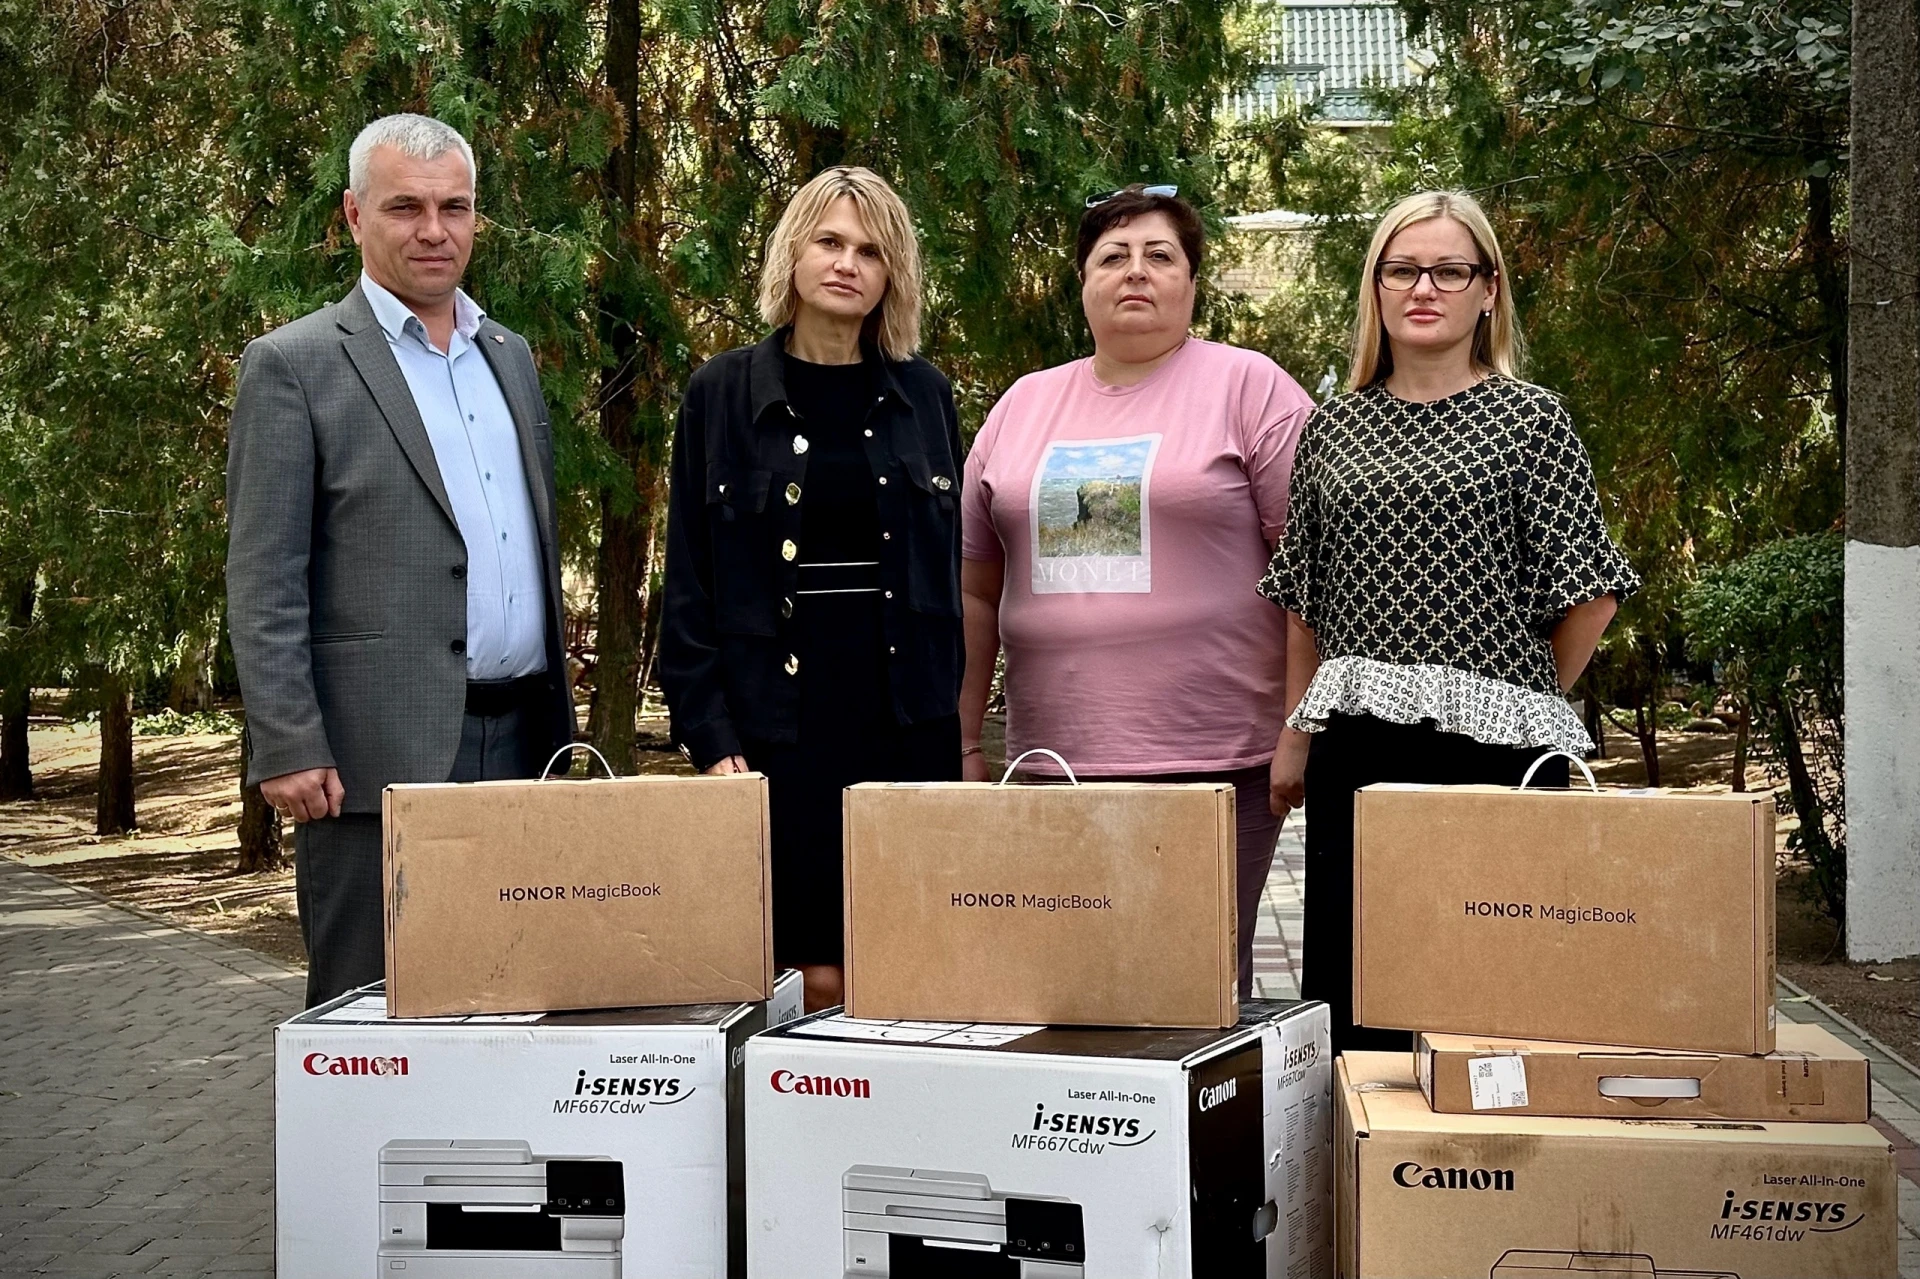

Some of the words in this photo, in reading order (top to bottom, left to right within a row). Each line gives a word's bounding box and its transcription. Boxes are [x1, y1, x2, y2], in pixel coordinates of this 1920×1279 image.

[1038, 561, 1145, 583] MONET
[499, 886, 566, 902] HONOR
[572, 882, 661, 901] MagicBook
[951, 893, 1016, 908] HONOR
[1022, 894, 1112, 912] MagicBook
[1464, 901, 1533, 919] HONOR
[1540, 905, 1637, 925] MagicBook
[303, 1052, 409, 1076] Canon
[609, 1054, 638, 1064] Laser
[640, 1054, 696, 1064] All-In-One
[732, 1043, 745, 1069] Can
[1284, 1040, 1316, 1071] i-SENSYS
[575, 1069, 681, 1096] i-SENSYS
[770, 1069, 871, 1099] Canon
[1198, 1076, 1237, 1112] Canon
[553, 1099, 646, 1114] MF667Cdw
[1068, 1088, 1097, 1100] Laser
[1099, 1090, 1156, 1105] All-In-One
[1033, 1103, 1141, 1138] i-SENSYS
[1011, 1134, 1105, 1154] MF667Cdw
[1392, 1161, 1514, 1191] Canon
[1763, 1174, 1797, 1185] Laser
[1800, 1174, 1866, 1187] All-In-One
[1721, 1190, 1847, 1223] i-SENSYS
[1710, 1224, 1806, 1242] MF461dw
